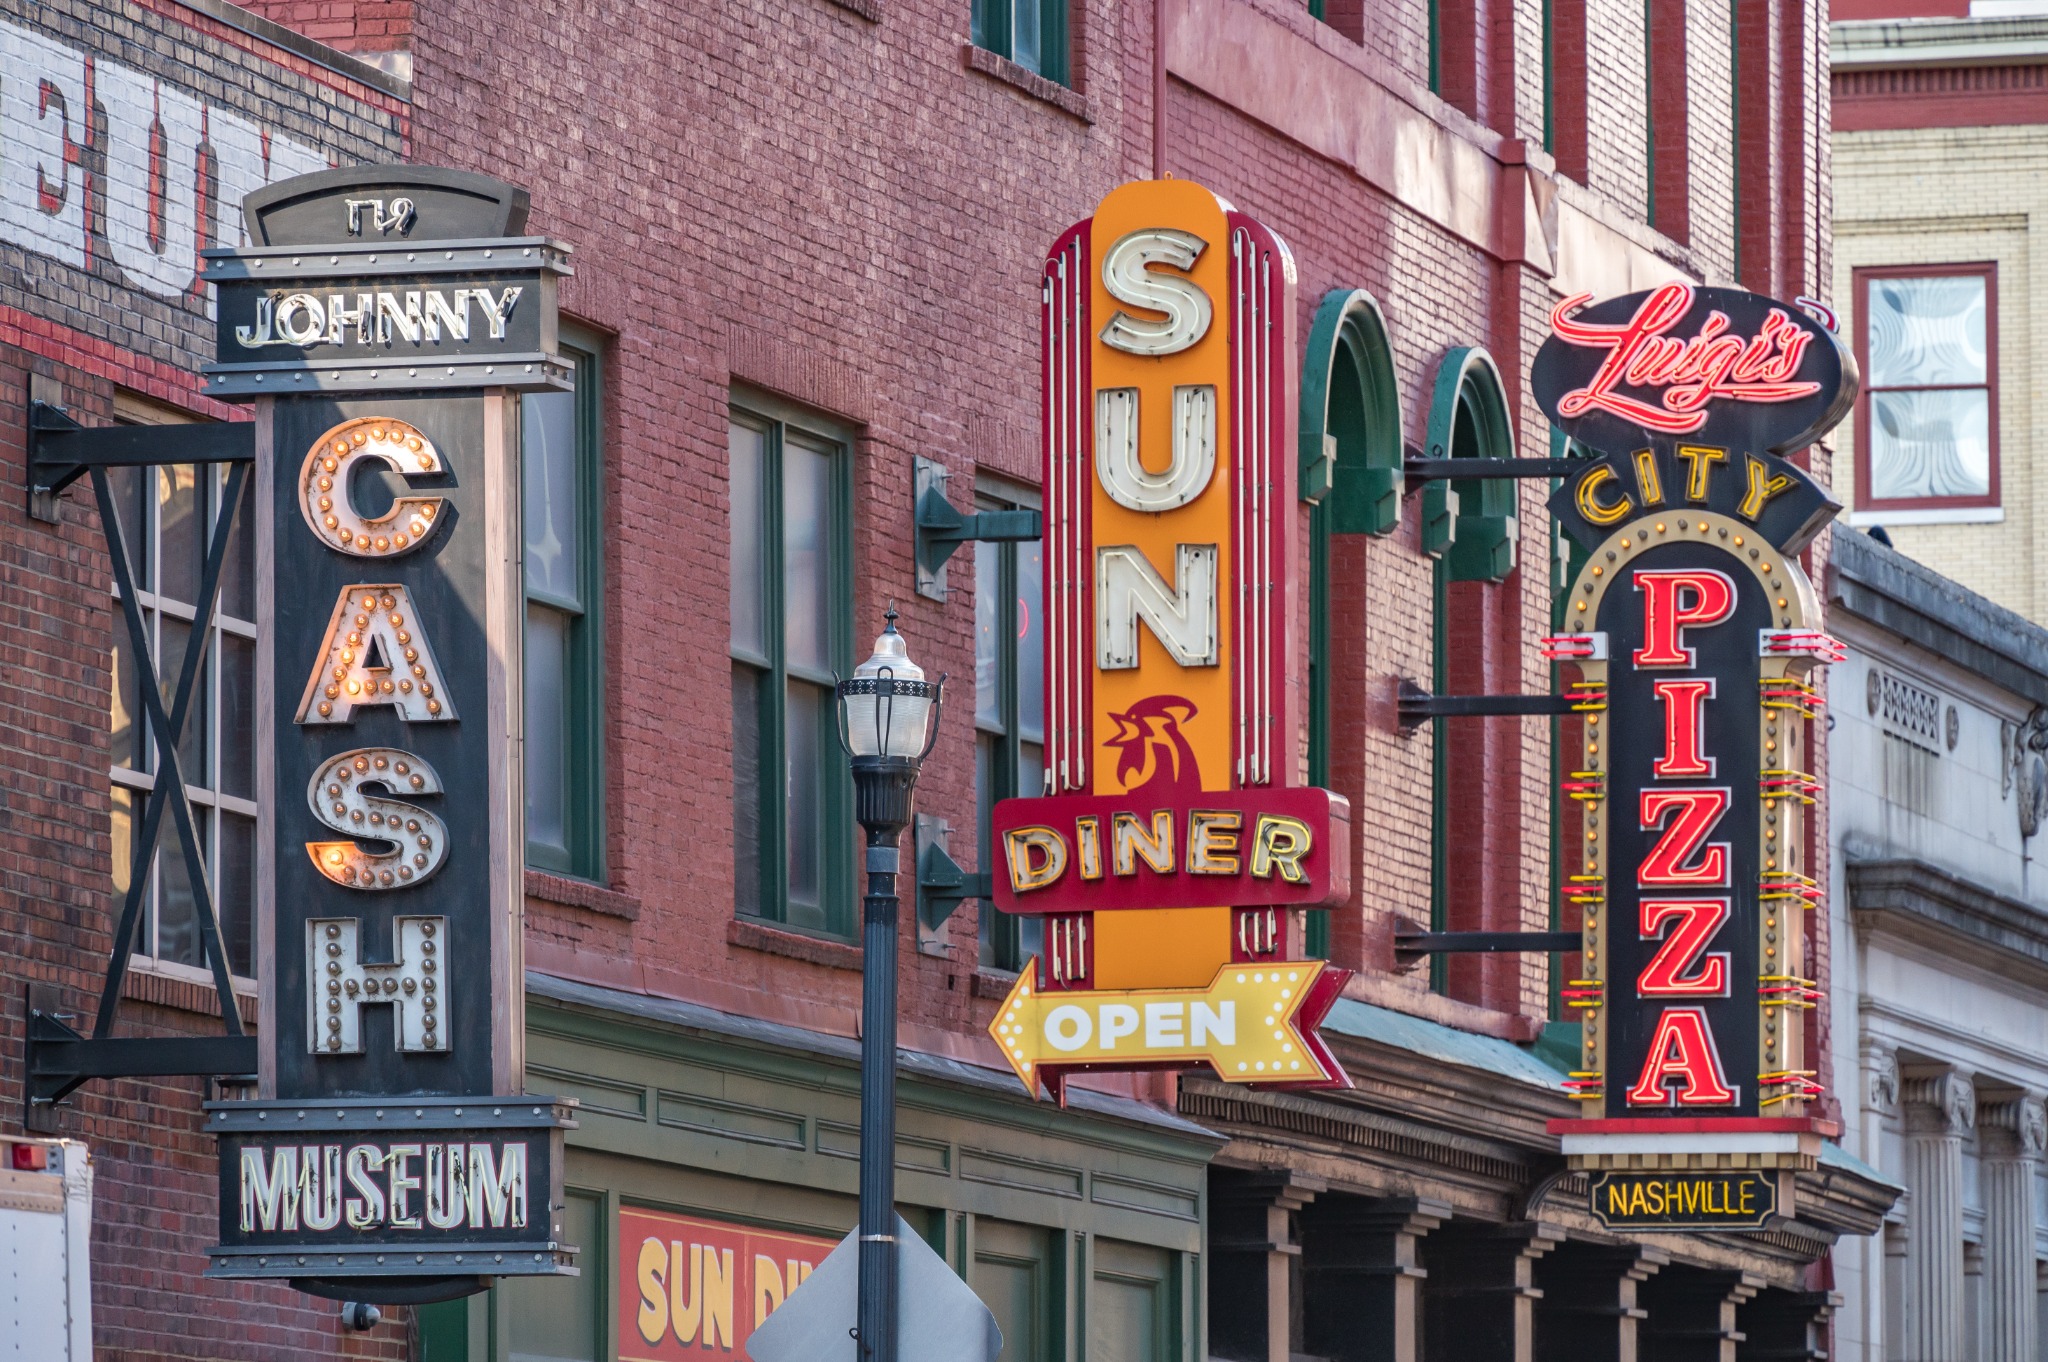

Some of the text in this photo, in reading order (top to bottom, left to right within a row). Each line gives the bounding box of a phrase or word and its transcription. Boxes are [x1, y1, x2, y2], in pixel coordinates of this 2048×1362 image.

[236, 286, 523, 348] JOHNNY
[1095, 227, 1219, 670] SUN
[1574, 441, 1800, 527] CITY
[294, 416, 461, 1055] CASH
[1003, 808, 1311, 893] DINER
[1626, 568, 1741, 1109] PIZZA
[1044, 1000, 1237, 1052] OPEN
[239, 1142, 529, 1232] MUSEUM
[1608, 1179, 1756, 1217] NASHVILLE
[636, 1236, 734, 1352] SUN
